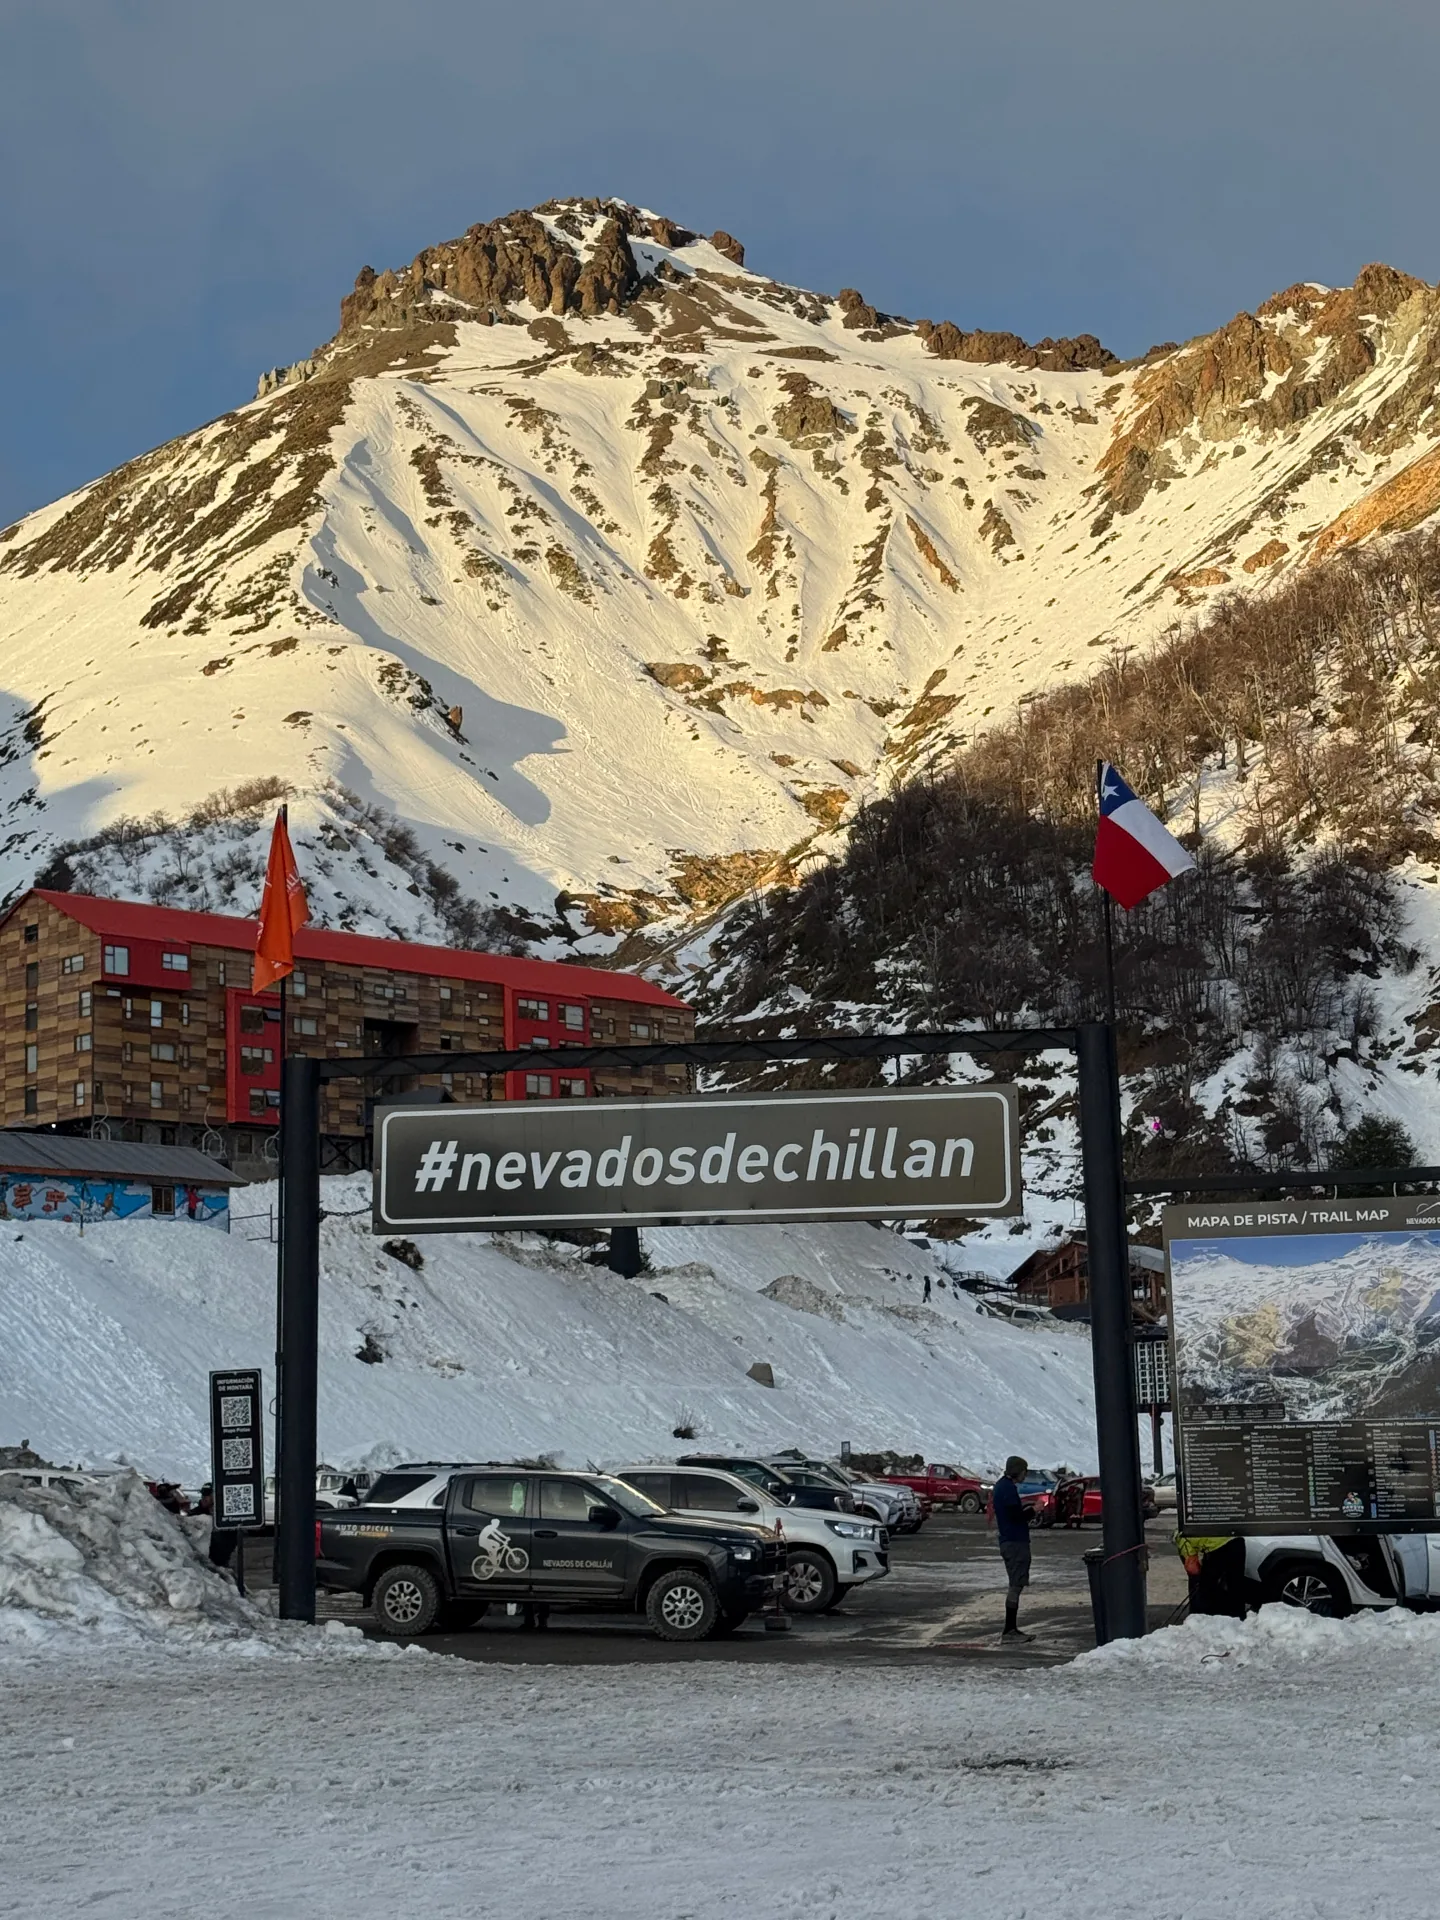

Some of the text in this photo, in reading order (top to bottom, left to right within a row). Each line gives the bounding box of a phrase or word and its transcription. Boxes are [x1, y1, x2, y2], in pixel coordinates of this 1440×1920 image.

[415, 1127, 975, 1193] #nevadosdechillan
[1188, 1210, 1389, 1228] MAPA DE PISTA / TRAIL MAP
[1406, 1216, 1436, 1224] NEVADOS
[585, 1558, 612, 1568] CHILLÁN
